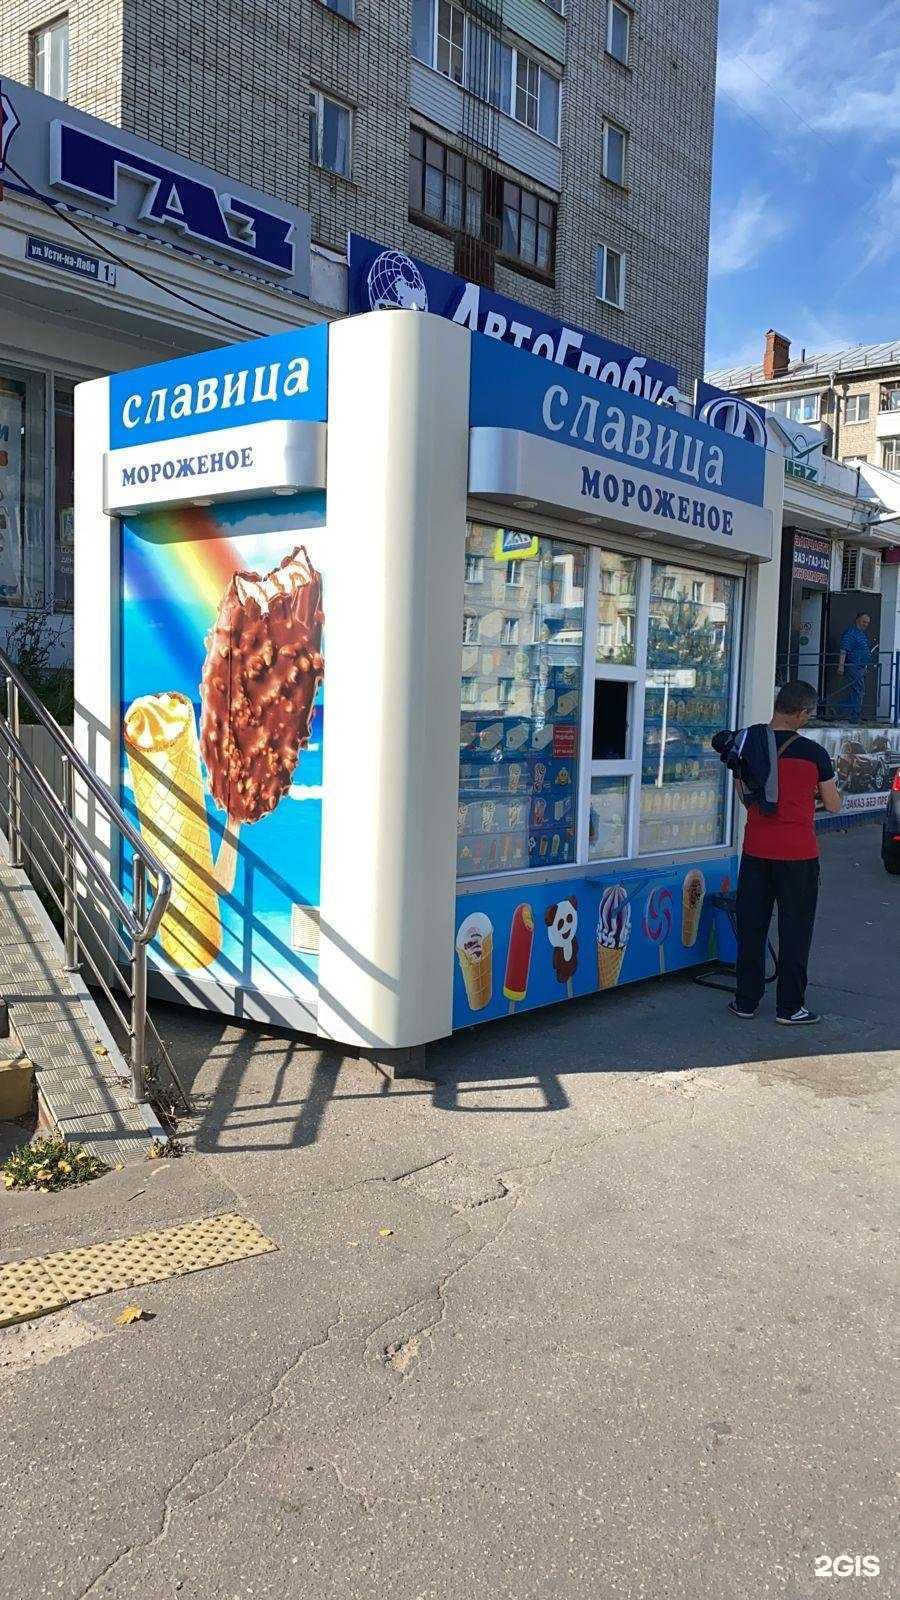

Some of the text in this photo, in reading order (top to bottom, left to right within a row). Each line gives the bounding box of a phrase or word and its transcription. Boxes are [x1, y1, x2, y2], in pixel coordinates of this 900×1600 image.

[51, 120, 296, 276] ГАЗ
[122, 446, 254, 487] МОРОЖЕНОЕ
[580, 466, 734, 536] МОРОЖЕНОЕ
